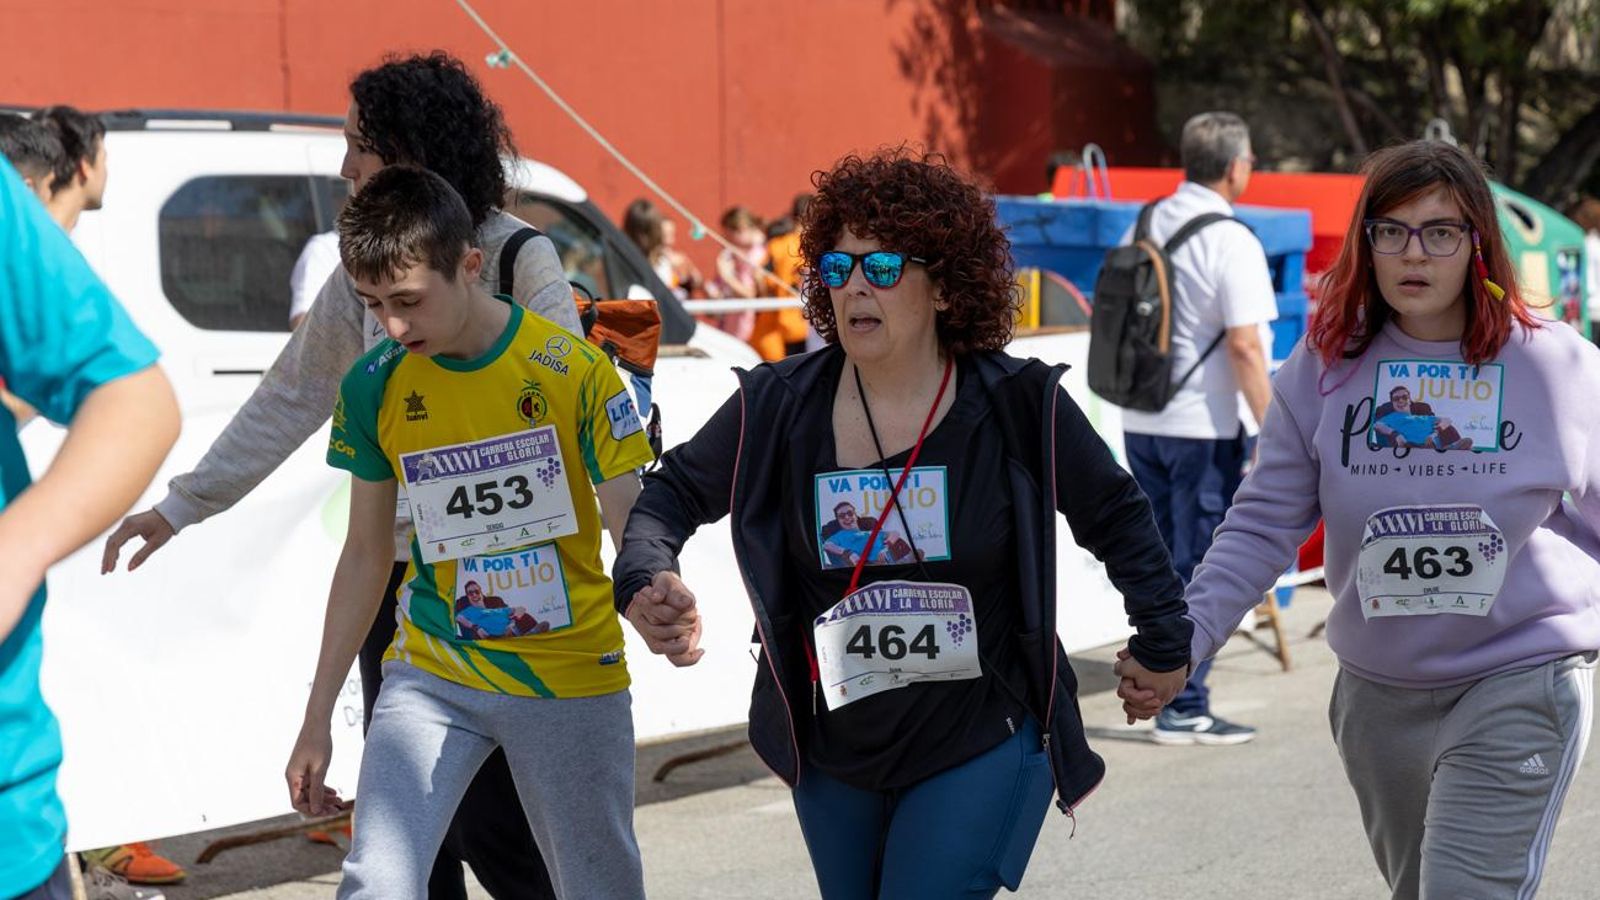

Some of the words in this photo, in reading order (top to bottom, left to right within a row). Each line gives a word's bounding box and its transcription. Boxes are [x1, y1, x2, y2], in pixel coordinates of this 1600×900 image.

[528, 350, 569, 376] JADISA
[1389, 364, 1409, 378] VA
[1417, 364, 1450, 378] POR
[1458, 365, 1479, 380] TI
[1414, 379, 1492, 402] JULIO
[480, 441, 514, 457] CARRERA
[515, 434, 549, 449] ESCOLAR
[488, 454, 500, 465] LA
[507, 445, 541, 461] GLORIA
[432, 449, 480, 475] XXXVI
[1350, 464, 1389, 476] MIND
[1409, 464, 1455, 476] VIBES
[1472, 462, 1507, 474] LIFE
[829, 478, 852, 493] VA
[446, 475, 534, 519] 453
[1374, 512, 1424, 535] XXXVI
[1424, 511, 1458, 522] CARRERA
[1432, 521, 1443, 531] LA
[1450, 520, 1486, 531] GLORIA
[463, 557, 478, 572] VA
[483, 557, 516, 573] POR
[520, 552, 539, 568] TI
[1383, 546, 1473, 580] 463
[486, 562, 554, 597] JULIO
[892, 588, 927, 599] CARRERA
[928, 589, 963, 600] ESCOLAR
[900, 598, 912, 609] LA
[920, 598, 954, 609] GLORIA
[846, 624, 940, 660] 464
